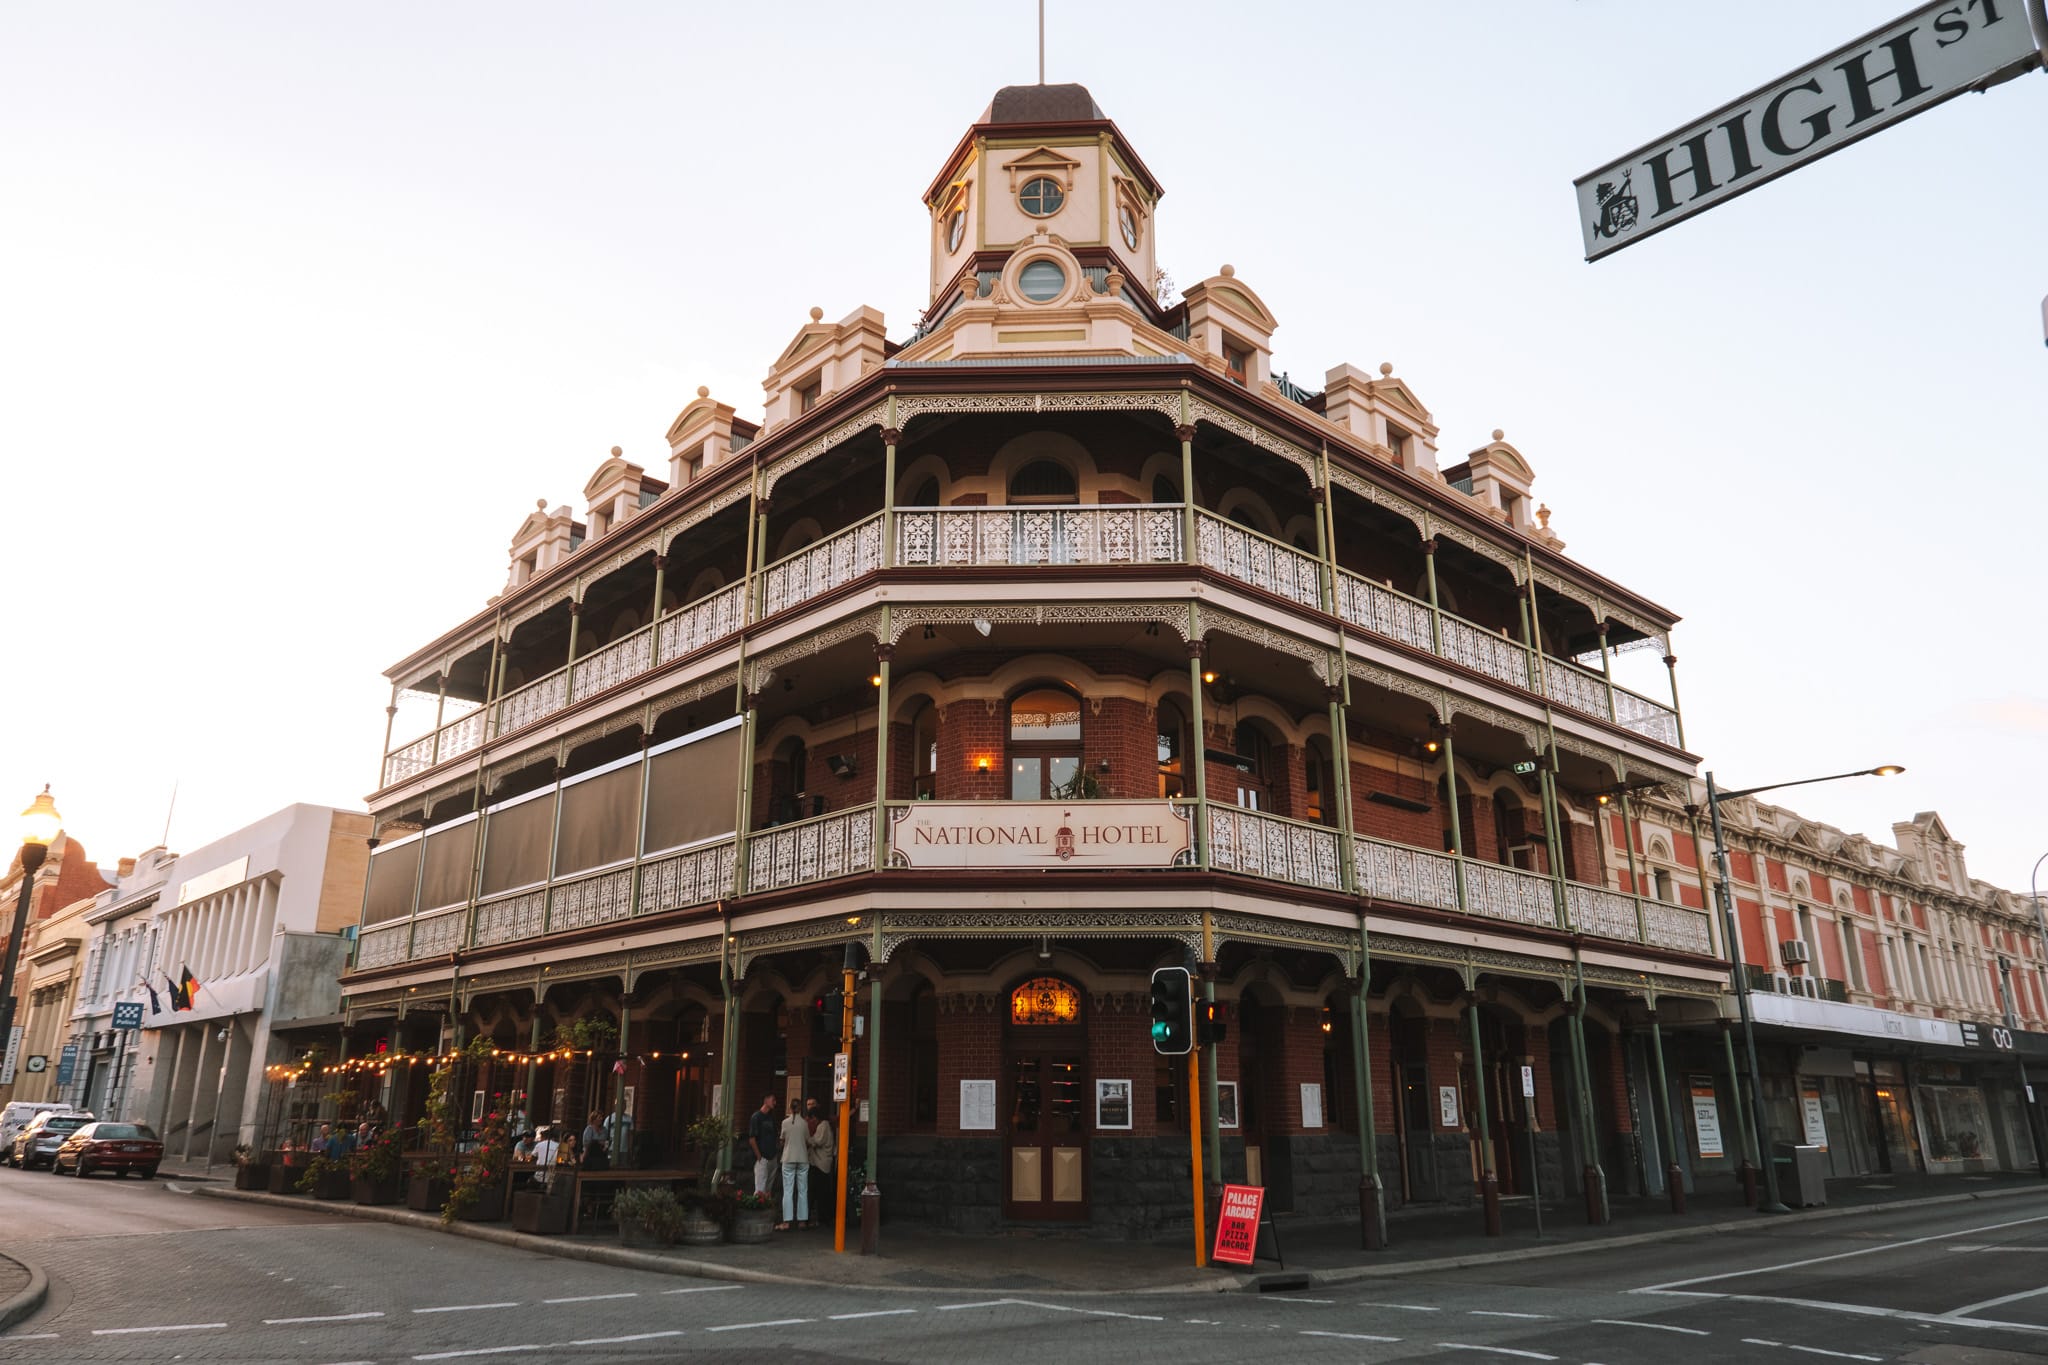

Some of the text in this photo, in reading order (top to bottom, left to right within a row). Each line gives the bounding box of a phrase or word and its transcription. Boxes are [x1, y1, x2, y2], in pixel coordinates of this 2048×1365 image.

[1642, 0, 2004, 219] HIGH ST
[914, 825, 1169, 845] NATIONAL HOTEL
[1227, 1191, 1259, 1206] PALACE
[1225, 1204, 1256, 1220] ARCADE
[1231, 1221, 1246, 1230] BAR
[1225, 1230, 1249, 1241] PIZZA
[1221, 1239, 1249, 1251] ARCADE
